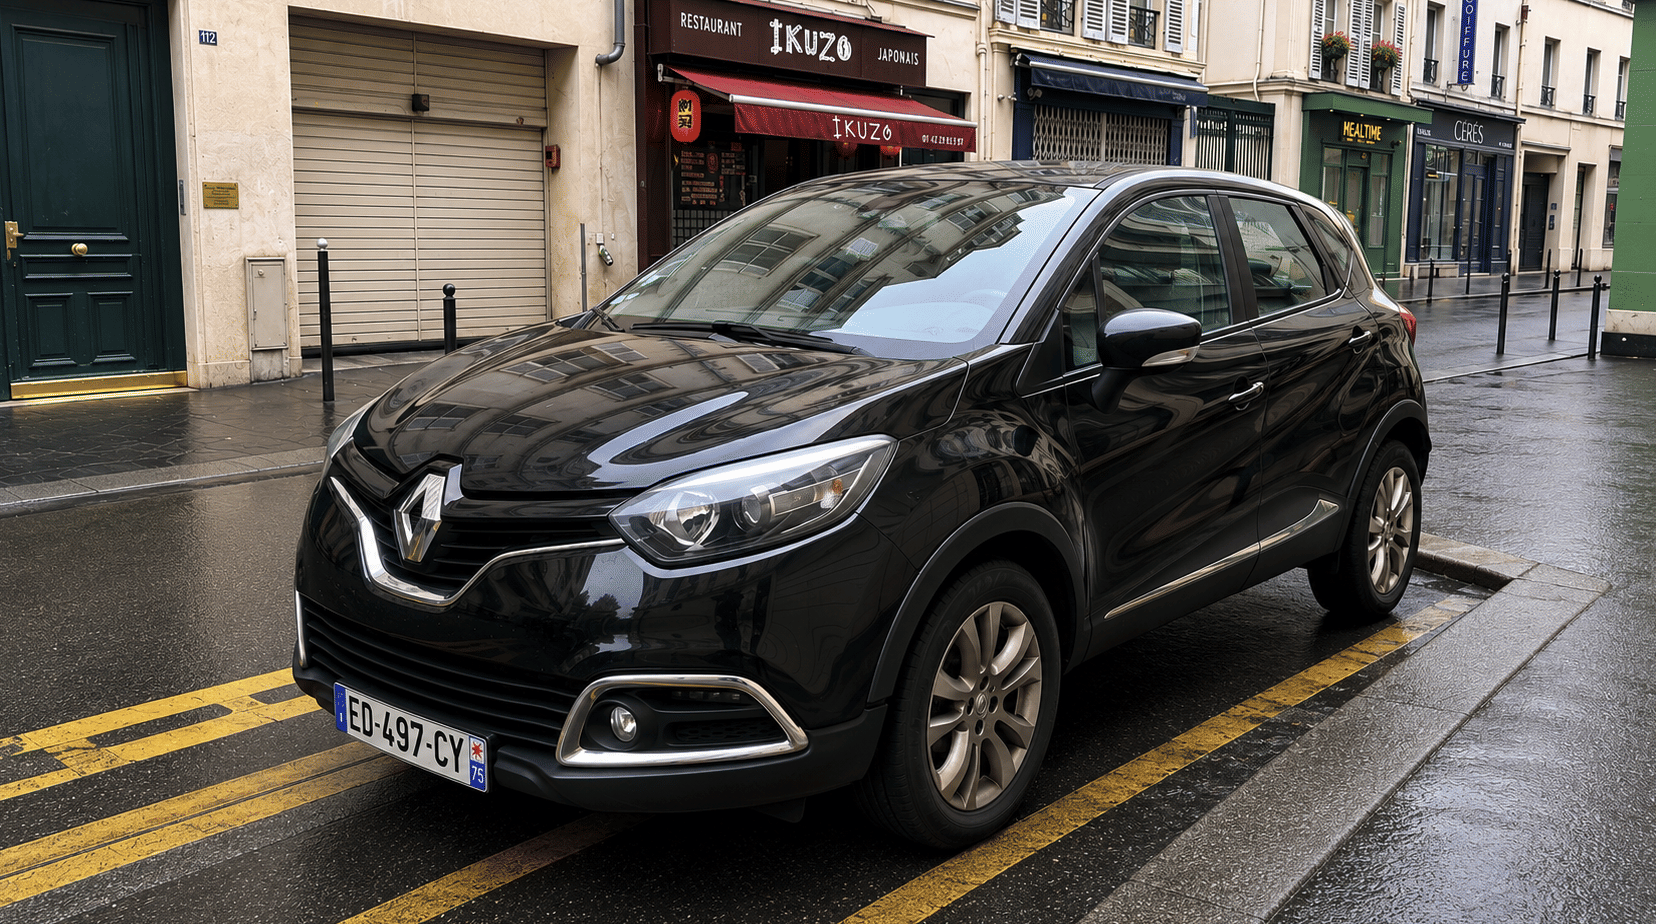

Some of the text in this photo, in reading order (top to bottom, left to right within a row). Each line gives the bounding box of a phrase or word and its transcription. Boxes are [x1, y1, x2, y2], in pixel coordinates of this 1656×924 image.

[201, 30, 216, 43] 112
[680, 11, 919, 66] RESTAURANT IKUZO JAPONAIS
[832, 115, 892, 141] IKUZO
[1342, 121, 1382, 141] MEALTIME
[349, 695, 465, 774] ED-497-CY
[471, 765, 485, 785] 75
